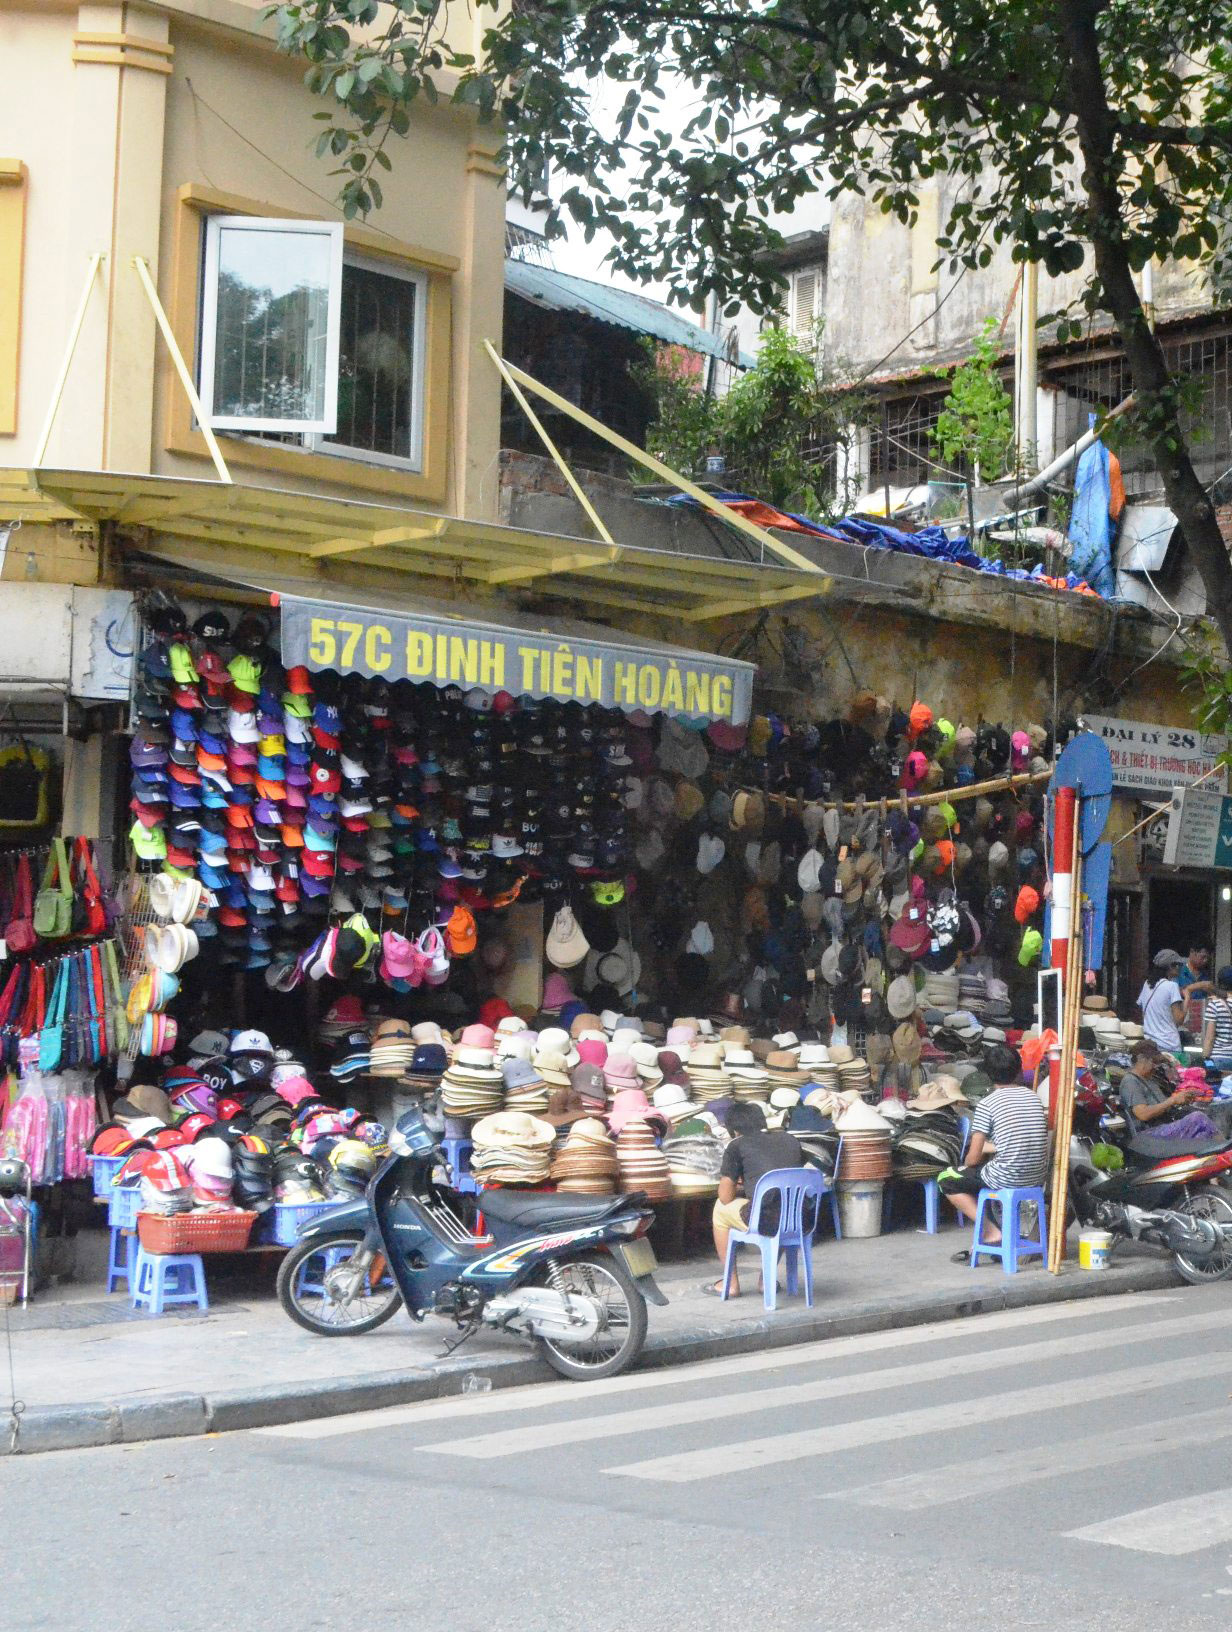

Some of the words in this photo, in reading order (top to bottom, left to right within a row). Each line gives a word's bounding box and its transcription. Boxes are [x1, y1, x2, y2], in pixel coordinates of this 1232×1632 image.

[309, 618, 392, 672] 57C
[405, 630, 505, 686] ĐINH
[518, 643, 602, 701] TIÊN
[614, 657, 735, 718] HOÀNG
[1102, 726, 1134, 742] ĐẠI
[1168, 732, 1196, 749] 28
[393, 1223, 422, 1231] HONDA
